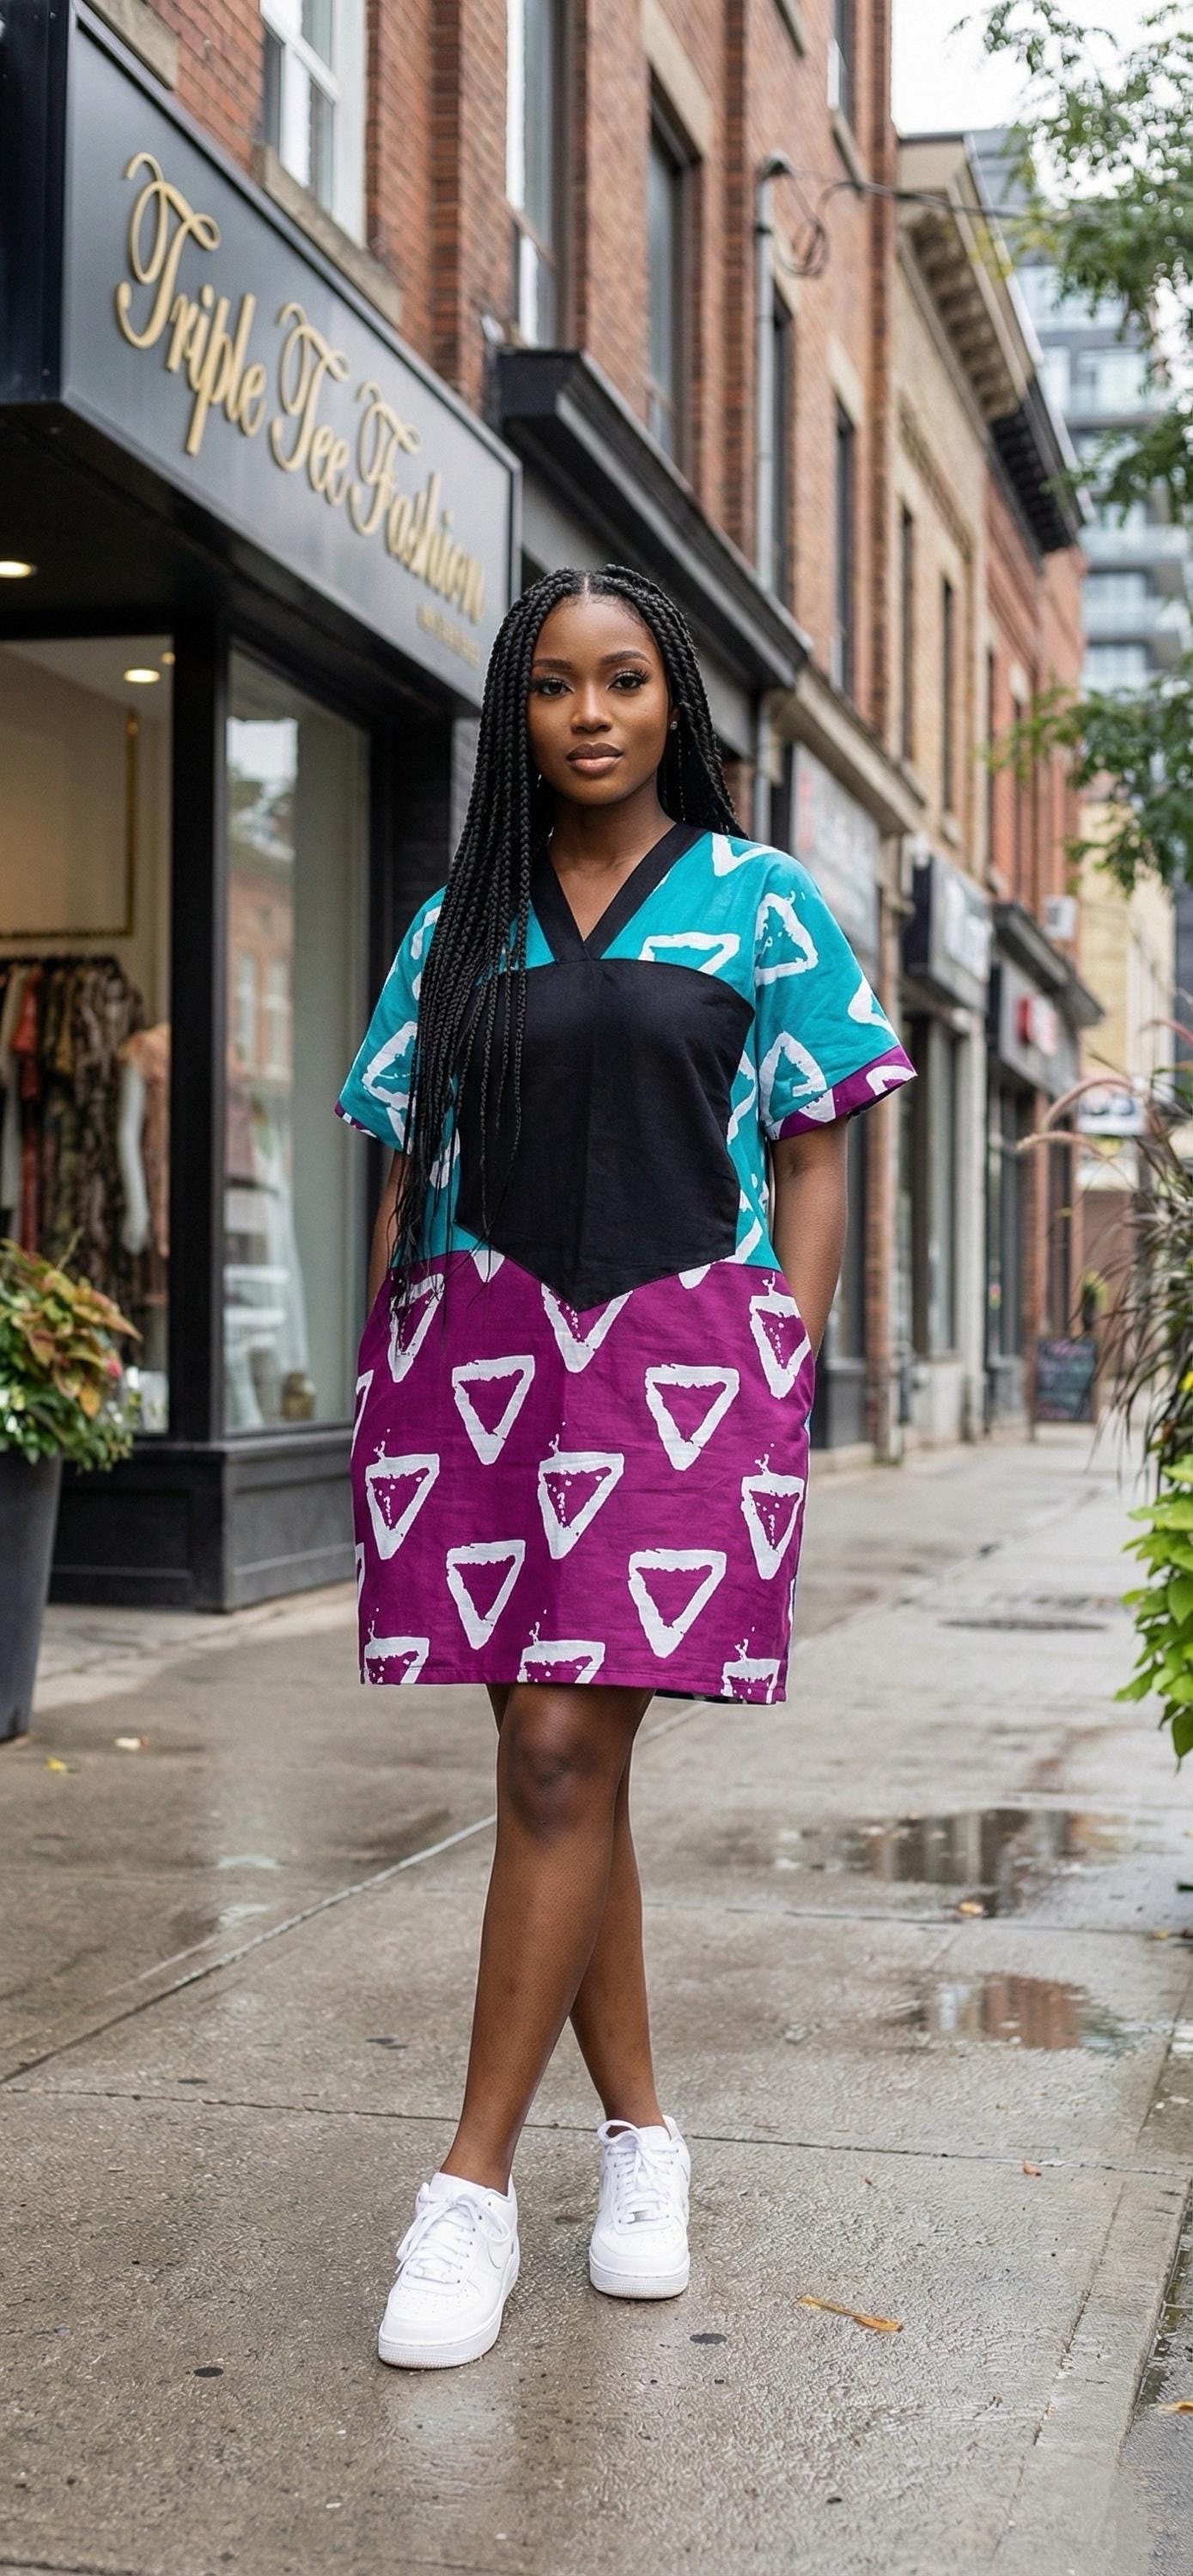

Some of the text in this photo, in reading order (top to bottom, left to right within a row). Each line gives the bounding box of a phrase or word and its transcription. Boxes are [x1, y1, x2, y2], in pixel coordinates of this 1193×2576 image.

[113, 152, 485, 626] Triple Tee Fashion
